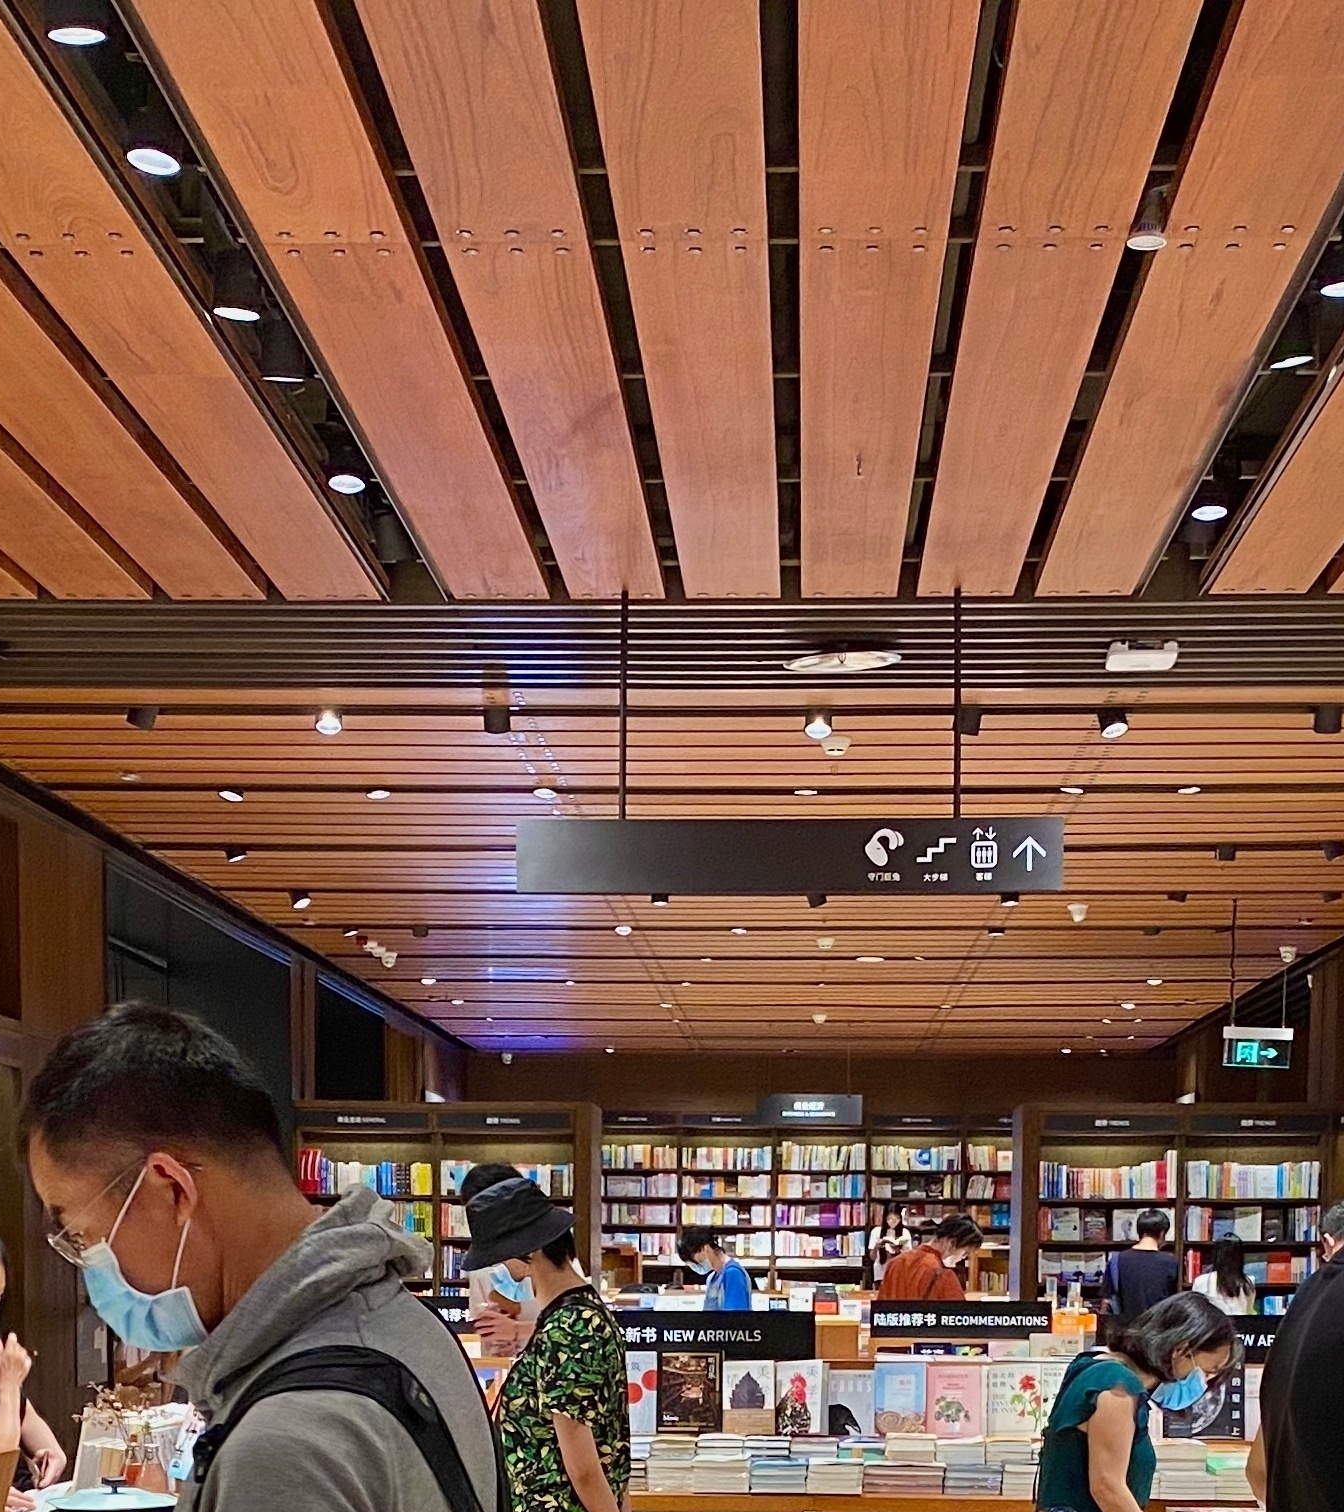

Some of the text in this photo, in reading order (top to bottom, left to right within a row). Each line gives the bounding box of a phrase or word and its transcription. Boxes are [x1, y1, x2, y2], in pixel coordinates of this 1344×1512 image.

[940, 1315, 1049, 1327] RECOMMENDATIONS
[663, 1330, 762, 1343] NEW ARRIVALS
